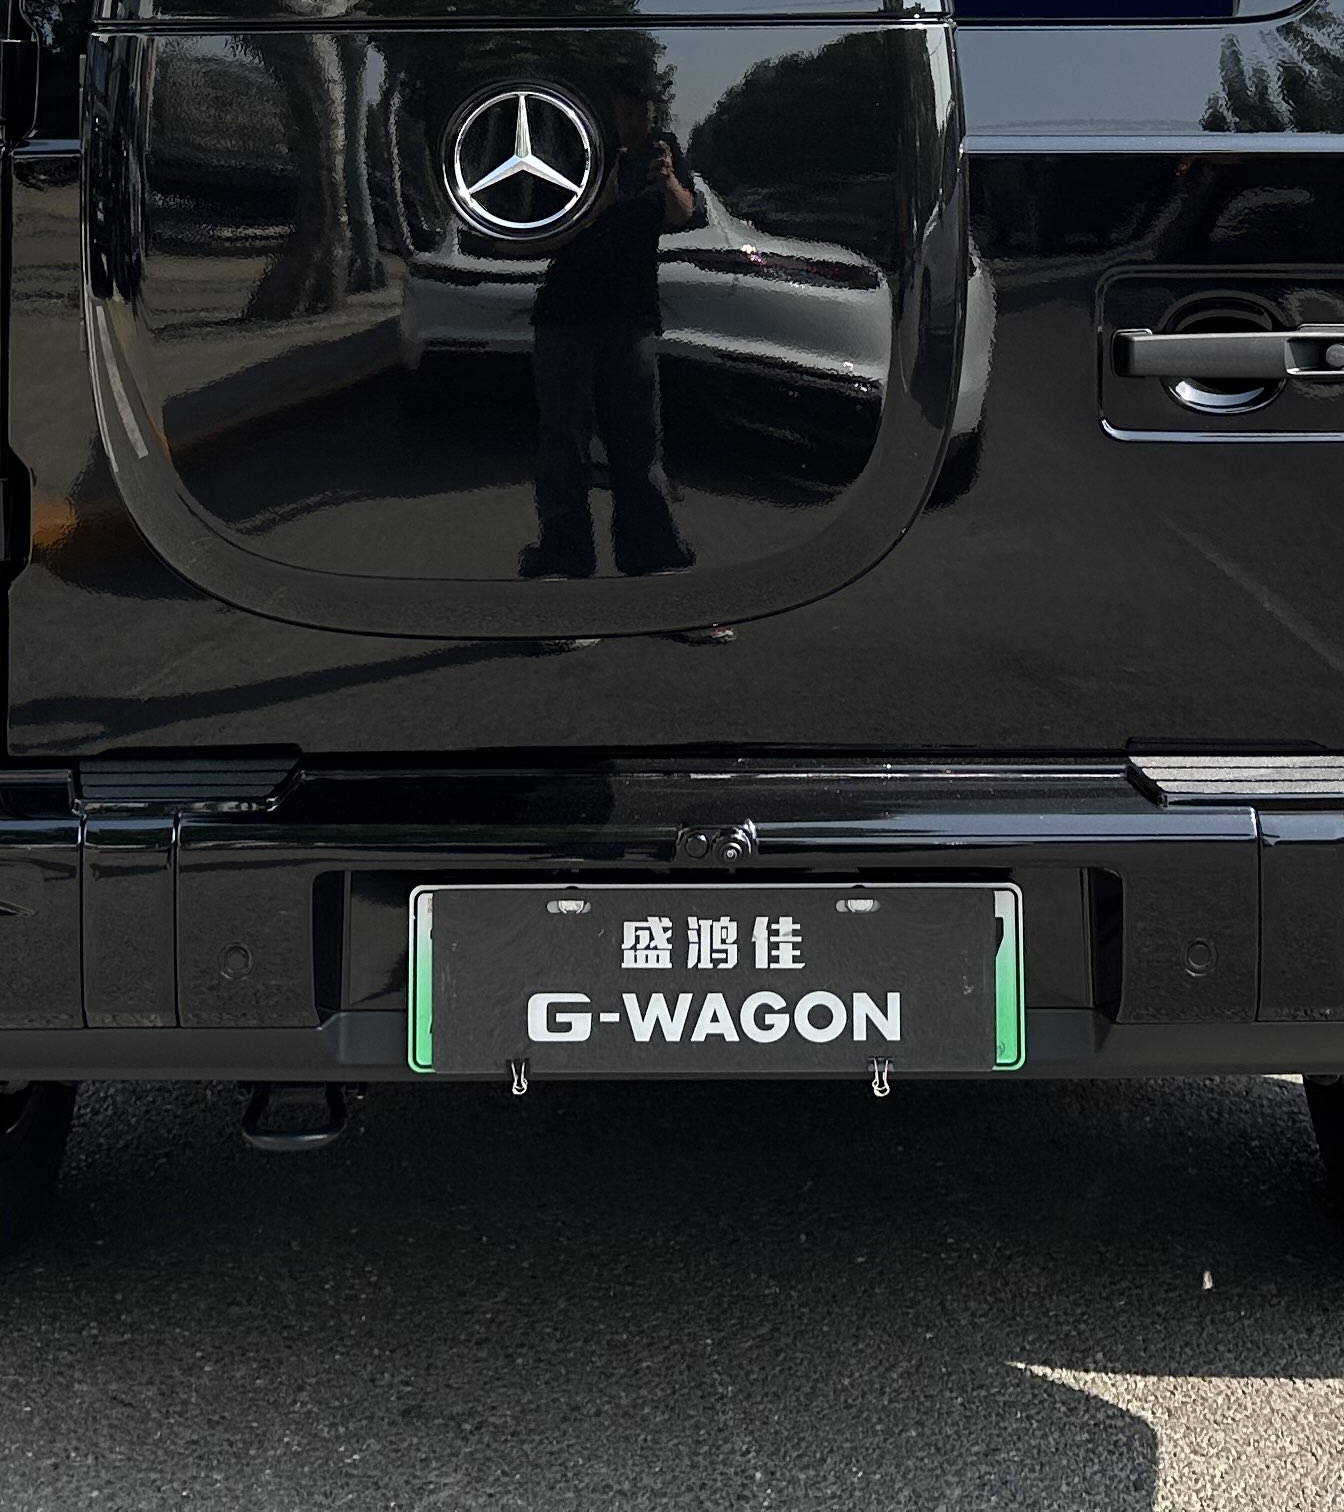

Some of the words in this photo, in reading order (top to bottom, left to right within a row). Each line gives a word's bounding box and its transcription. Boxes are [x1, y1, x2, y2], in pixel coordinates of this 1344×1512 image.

[620, 916, 806, 970] 盛鸿佳
[526, 990, 902, 1043] G-WAGON
